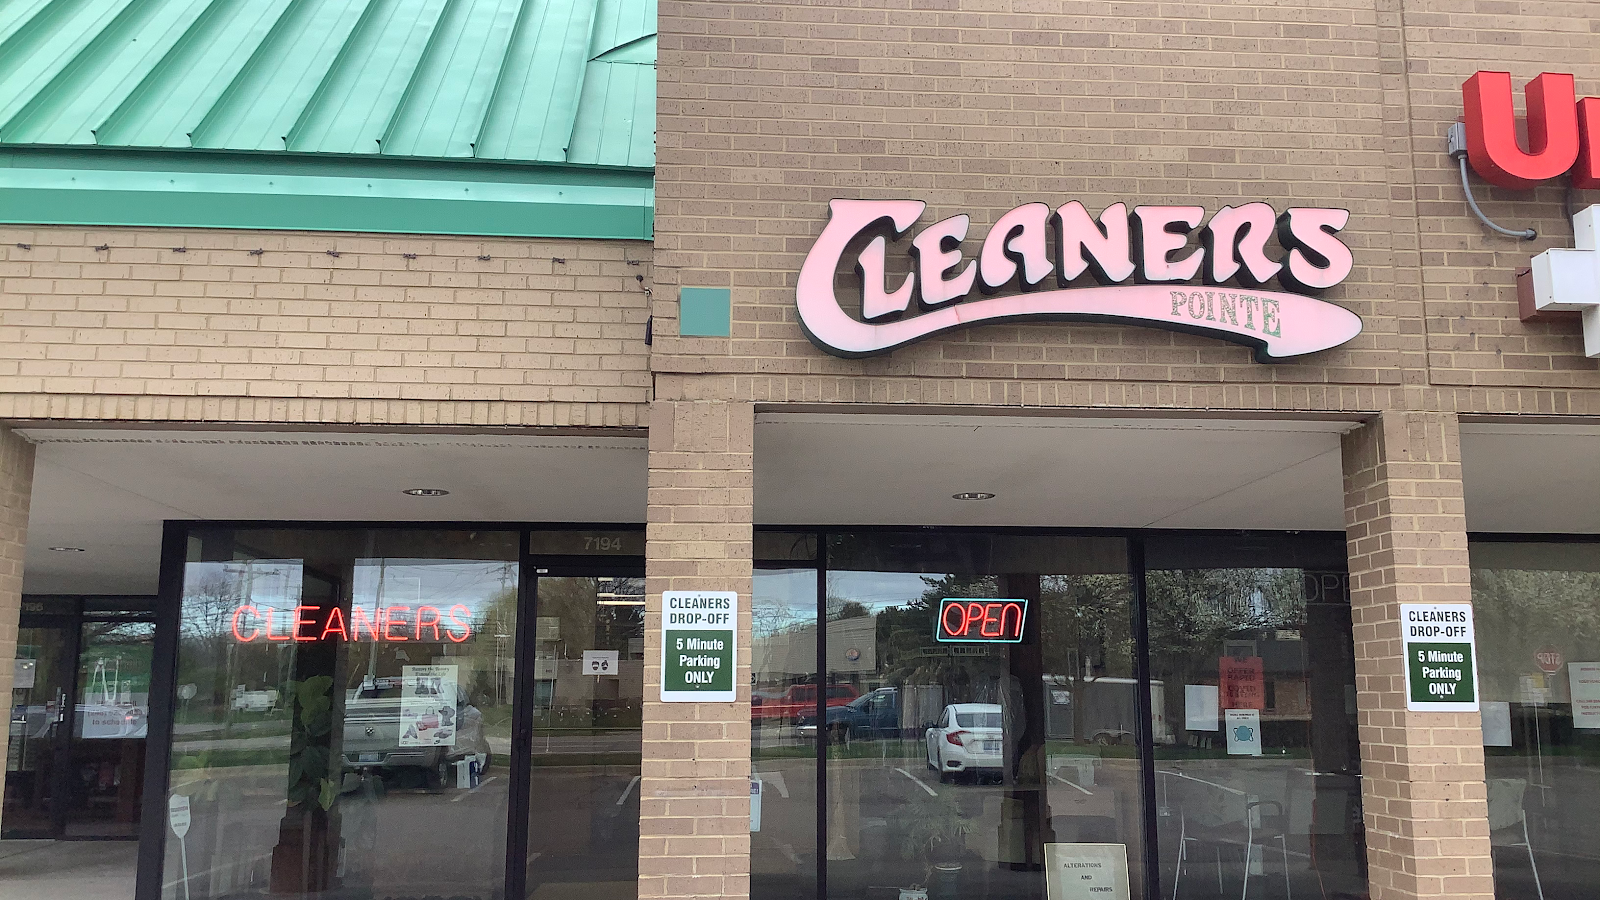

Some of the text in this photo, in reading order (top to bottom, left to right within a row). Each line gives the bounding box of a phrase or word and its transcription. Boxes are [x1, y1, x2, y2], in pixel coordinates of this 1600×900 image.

[1462, 70, 1600, 190] U
[795, 198, 1354, 358] CLEANERS
[1169, 290, 1281, 338] POINTE
[584, 536, 622, 550] 7194
[669, 597, 730, 609] CLEANERS
[669, 613, 730, 624] DROP-OFF
[942, 603, 1021, 637] OPEN
[1408, 610, 1466, 622] CLEANERS
[231, 604, 472, 643] CLEANERS
[1410, 625, 1467, 637] DROP-OFF
[676, 638, 724, 650] 5 Minute
[679, 654, 721, 669] Parking
[1417, 650, 1464, 663] 5 Minute
[684, 671, 715, 684] ONLY
[1422, 666, 1462, 681] Parking
[1428, 682, 1457, 695] ONLY
